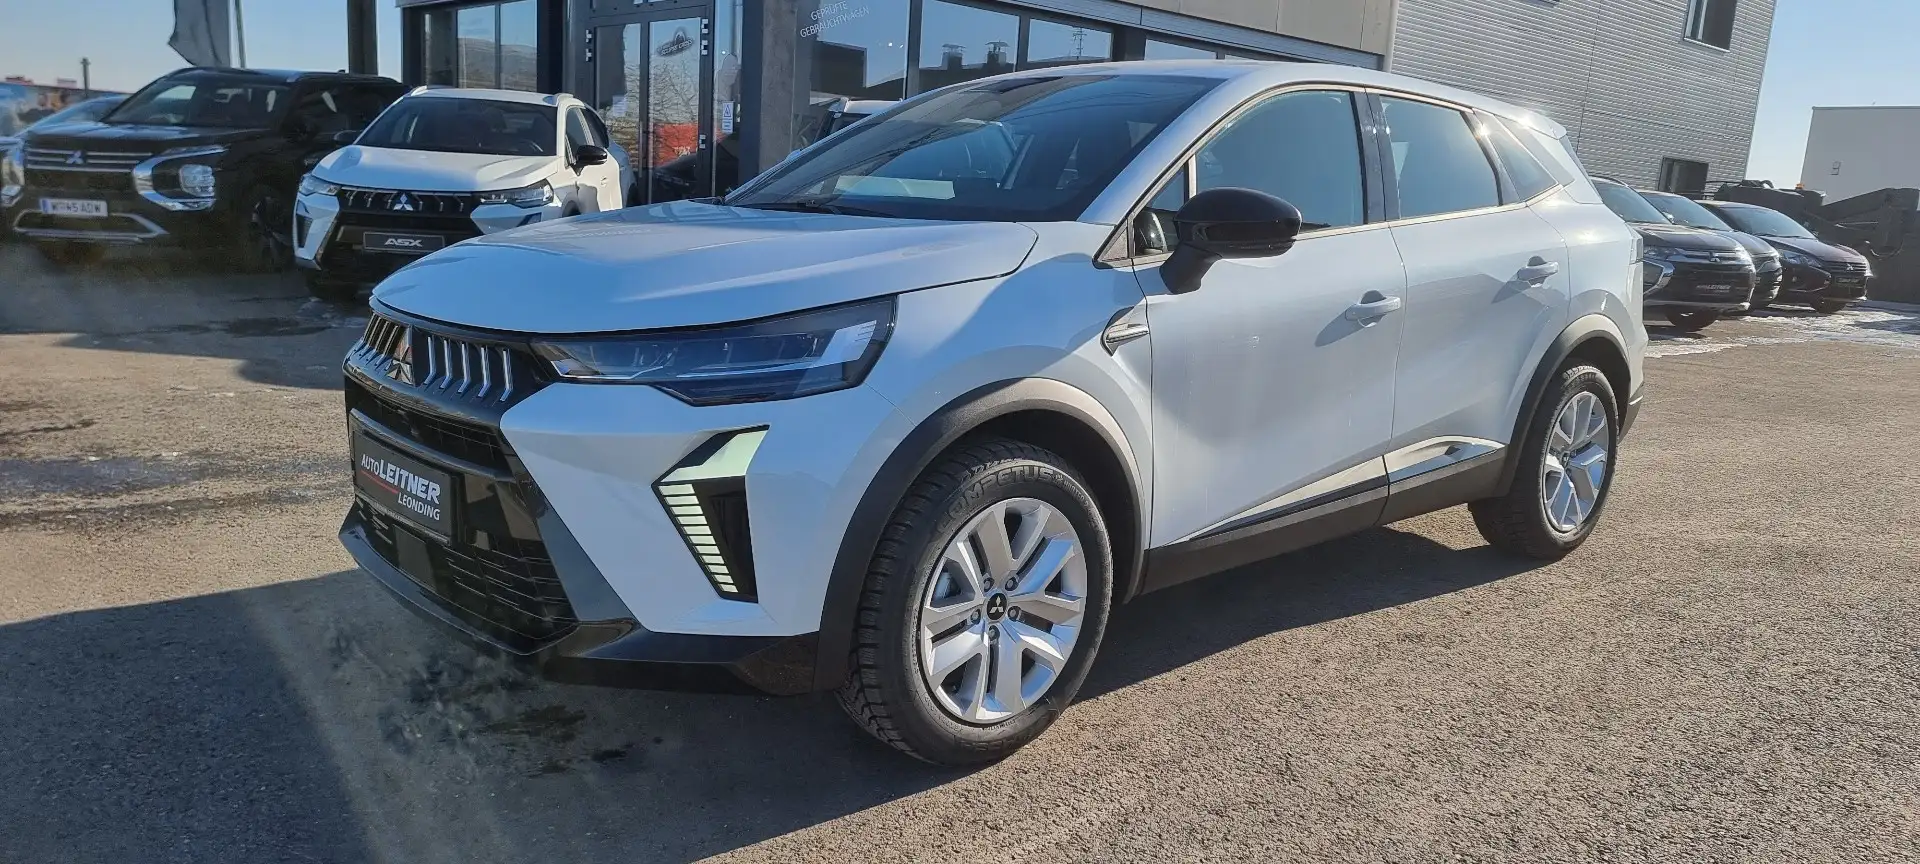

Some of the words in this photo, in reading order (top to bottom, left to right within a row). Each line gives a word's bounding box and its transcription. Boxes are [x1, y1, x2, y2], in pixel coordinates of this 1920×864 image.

[800, 5, 869, 37] GEBRAUCHTWAGEN
[811, 1, 848, 20] GEPRÜFTE
[384, 238, 422, 247] ASX
[398, 492, 440, 520] LEONDING
